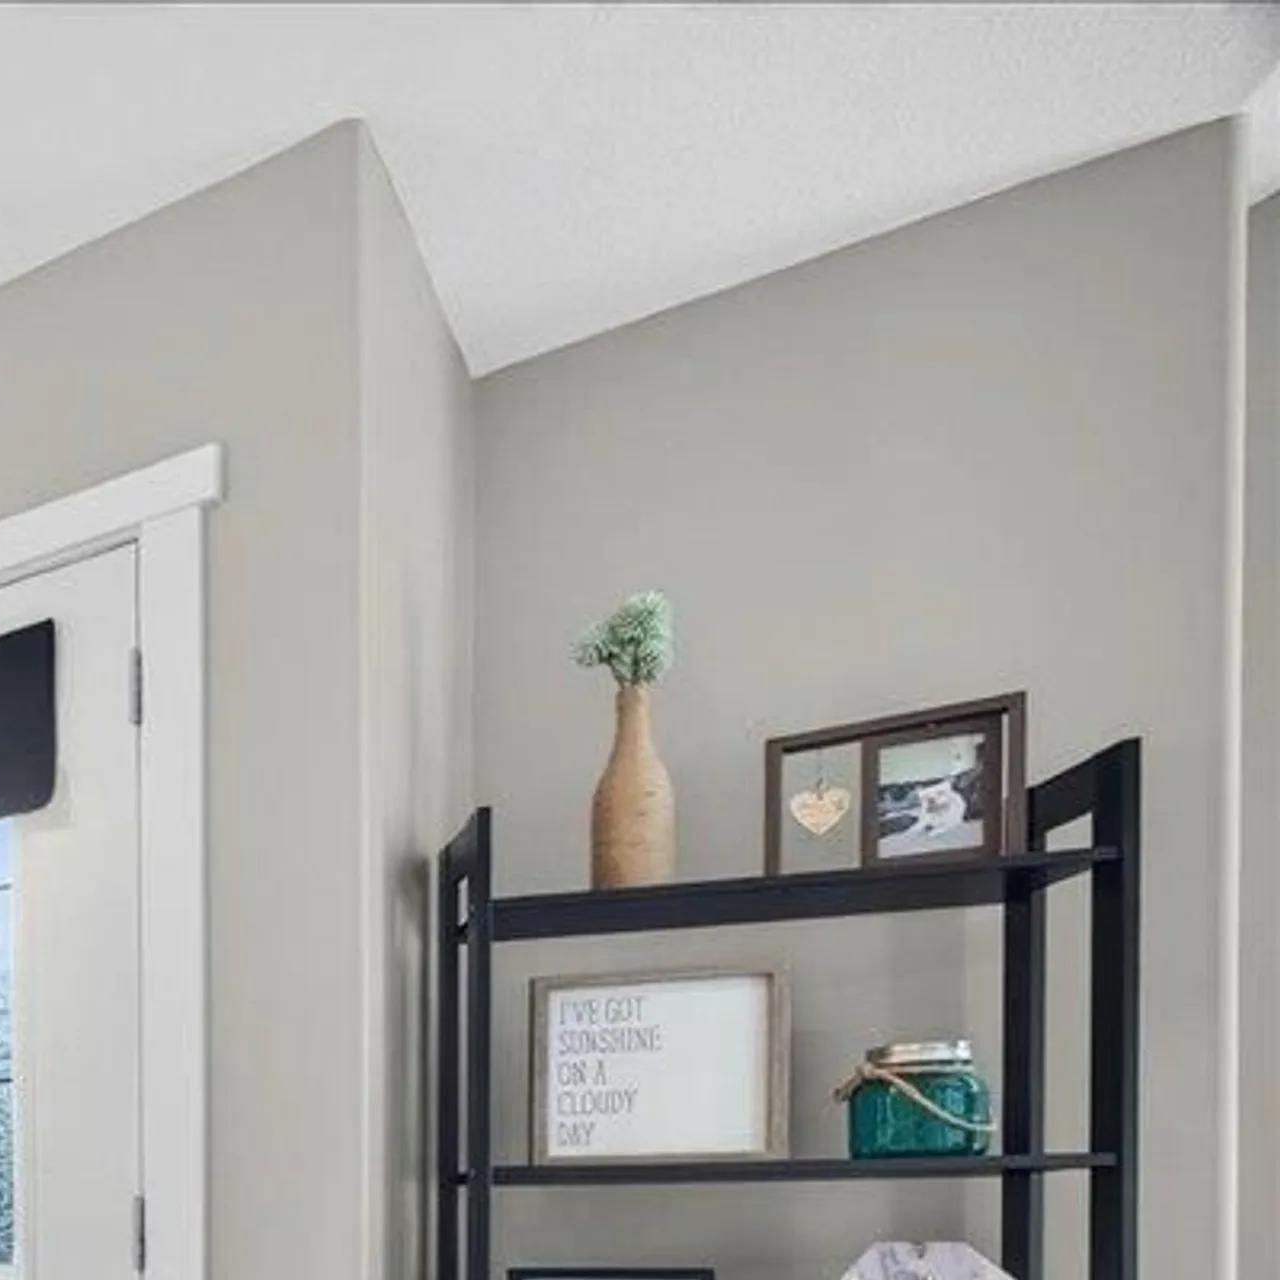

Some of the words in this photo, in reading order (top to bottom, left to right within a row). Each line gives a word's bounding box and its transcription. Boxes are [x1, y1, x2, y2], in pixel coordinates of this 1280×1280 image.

[559, 998, 599, 1025] I'VE
[605, 995, 646, 1023] GOT
[559, 1024, 664, 1055] SUNSHINE
[557, 1059, 587, 1086] ON
[594, 1058, 607, 1086] A
[557, 1088, 639, 1115] CLOUDY
[557, 1121, 596, 1147] DAY
